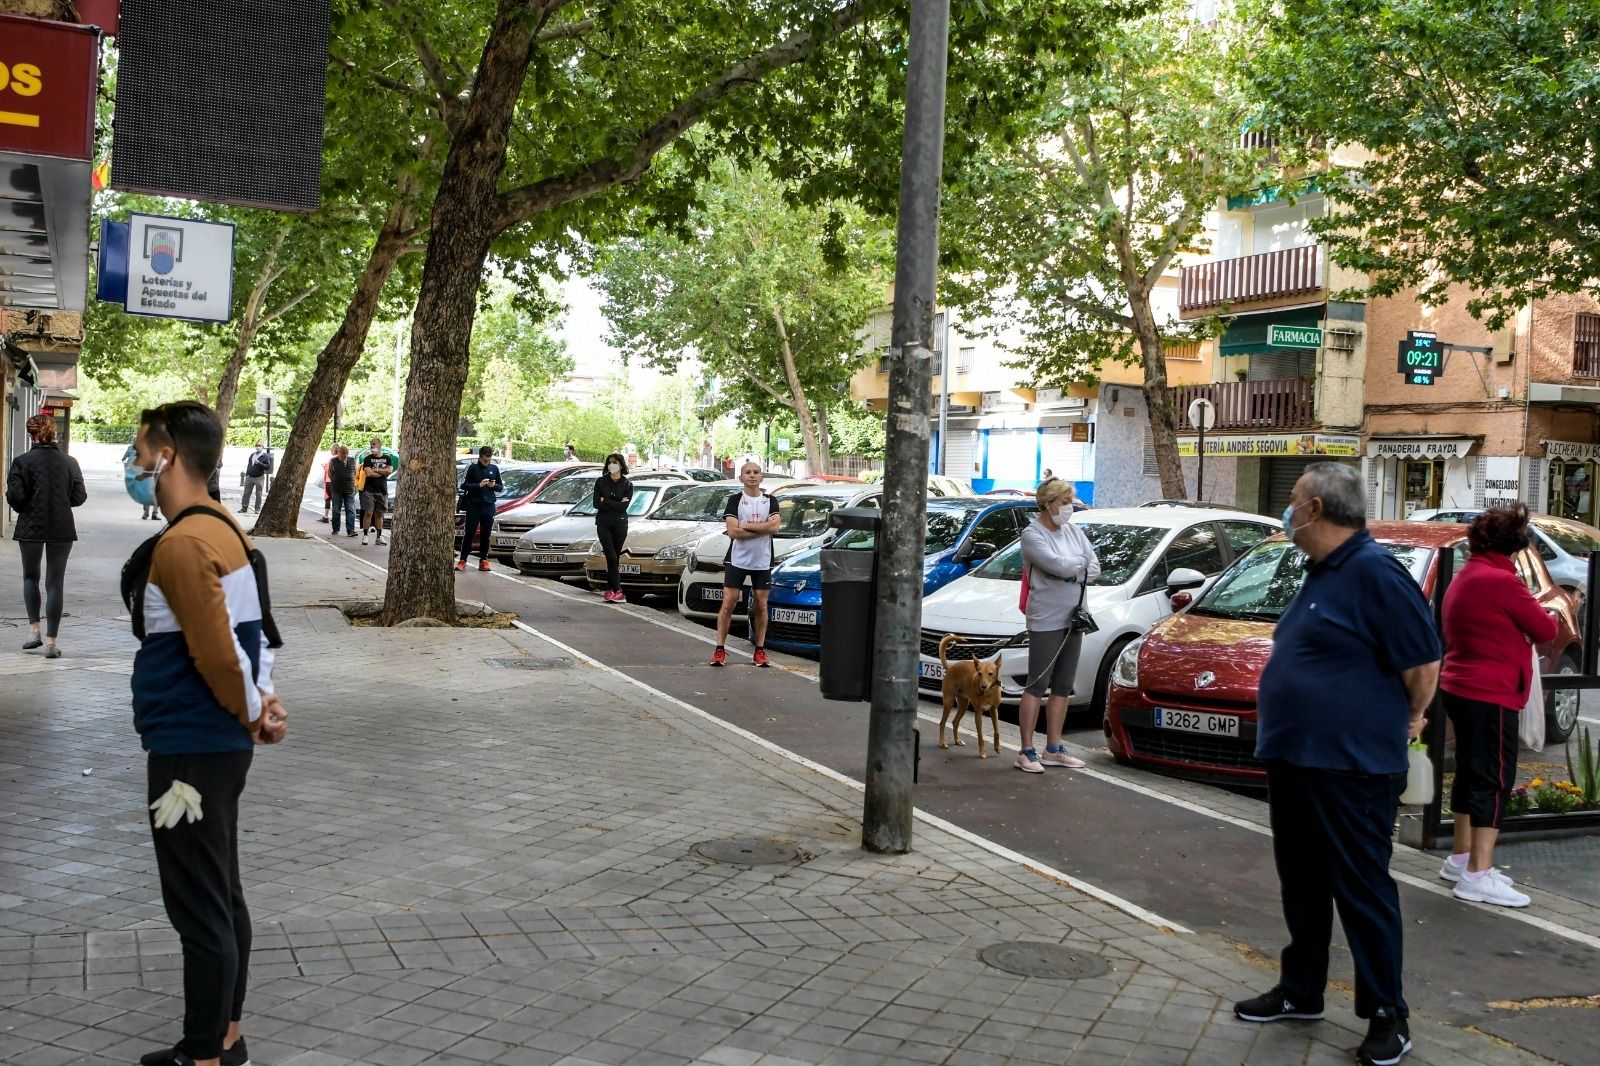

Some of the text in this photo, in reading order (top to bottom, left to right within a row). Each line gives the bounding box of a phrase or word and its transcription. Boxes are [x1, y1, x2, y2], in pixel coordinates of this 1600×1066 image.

[142, 275, 192, 290] Loterías y
[141, 286, 207, 301] Apuestas del
[140, 297, 176, 309] Estado
[1273, 329, 1320, 344] FARMACIA
[1407, 350, 1439, 367] 09:21
[1193, 437, 1288, 454] FUTERÍA ANDRÉS SEGOVIA
[1378, 444, 1457, 453] PANADERIA FRAYDA
[1549, 442, 1582, 456] LECHERIA
[1585, 445, 1591, 457] Y
[1485, 479, 1518, 490] CONGELADOS
[706, 589, 723, 599] 2160
[776, 611, 815, 623] 8797 HHC
[1166, 712, 1236, 733] 3262 GMP
